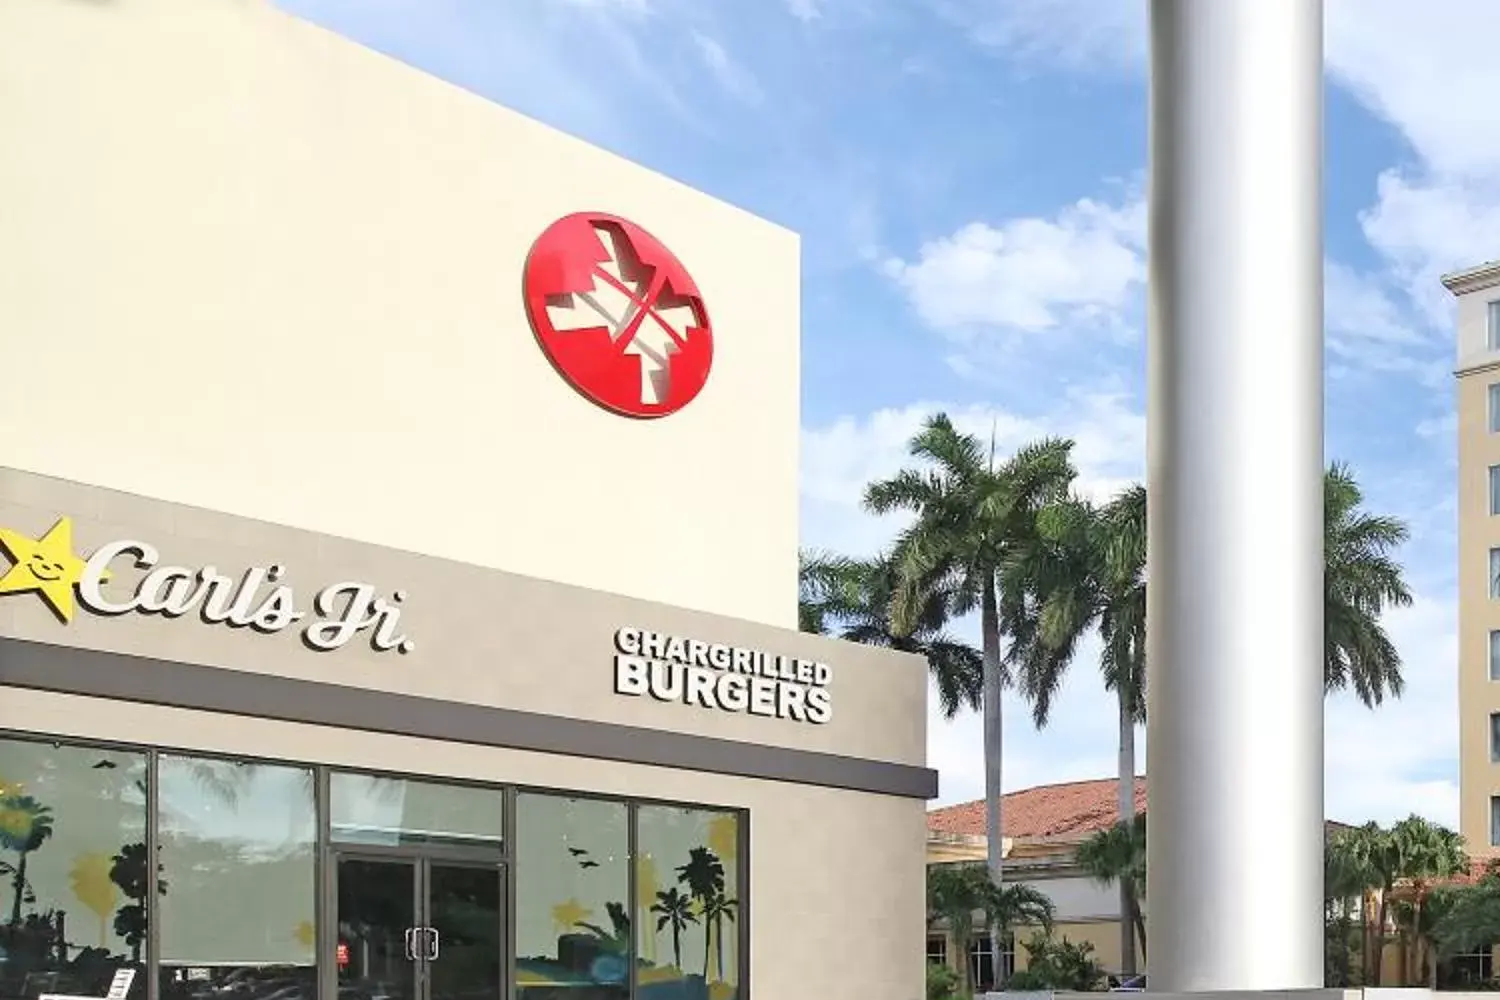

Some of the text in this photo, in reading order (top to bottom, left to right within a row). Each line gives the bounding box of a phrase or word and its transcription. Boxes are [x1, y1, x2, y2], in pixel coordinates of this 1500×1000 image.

[76, 540, 305, 632] Carl's
[614, 626, 832, 685] CHARGRILLED
[614, 655, 832, 724] BURGERS
